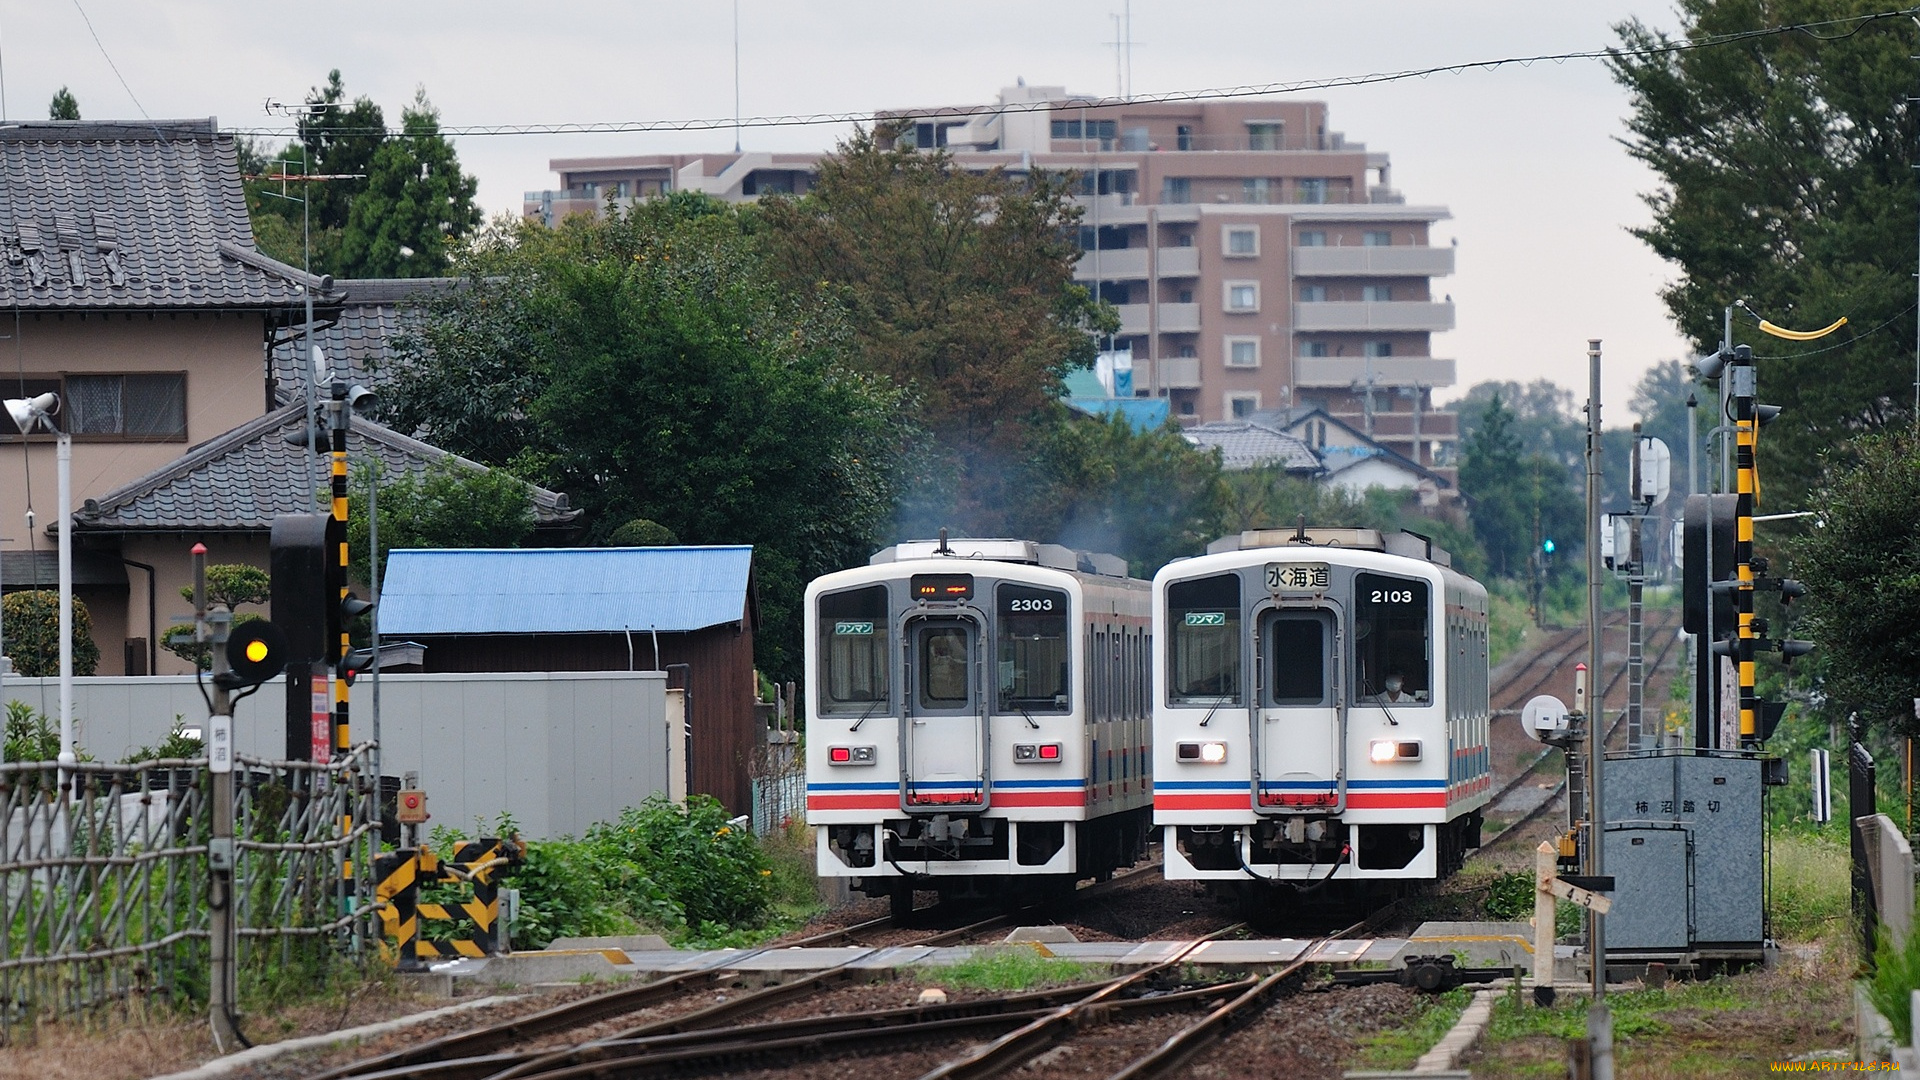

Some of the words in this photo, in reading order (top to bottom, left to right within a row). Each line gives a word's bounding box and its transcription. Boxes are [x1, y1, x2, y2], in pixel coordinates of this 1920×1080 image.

[1268, 566, 1329, 588] 水海道
[1371, 590, 1412, 603] 2103
[1011, 599, 1053, 612] 2303
[1188, 614, 1223, 624] ワンマン
[838, 624, 872, 633] ワンマン
[1635, 800, 1721, 814] 柿沼踏切
[1566, 888, 1592, 906] 4.5
